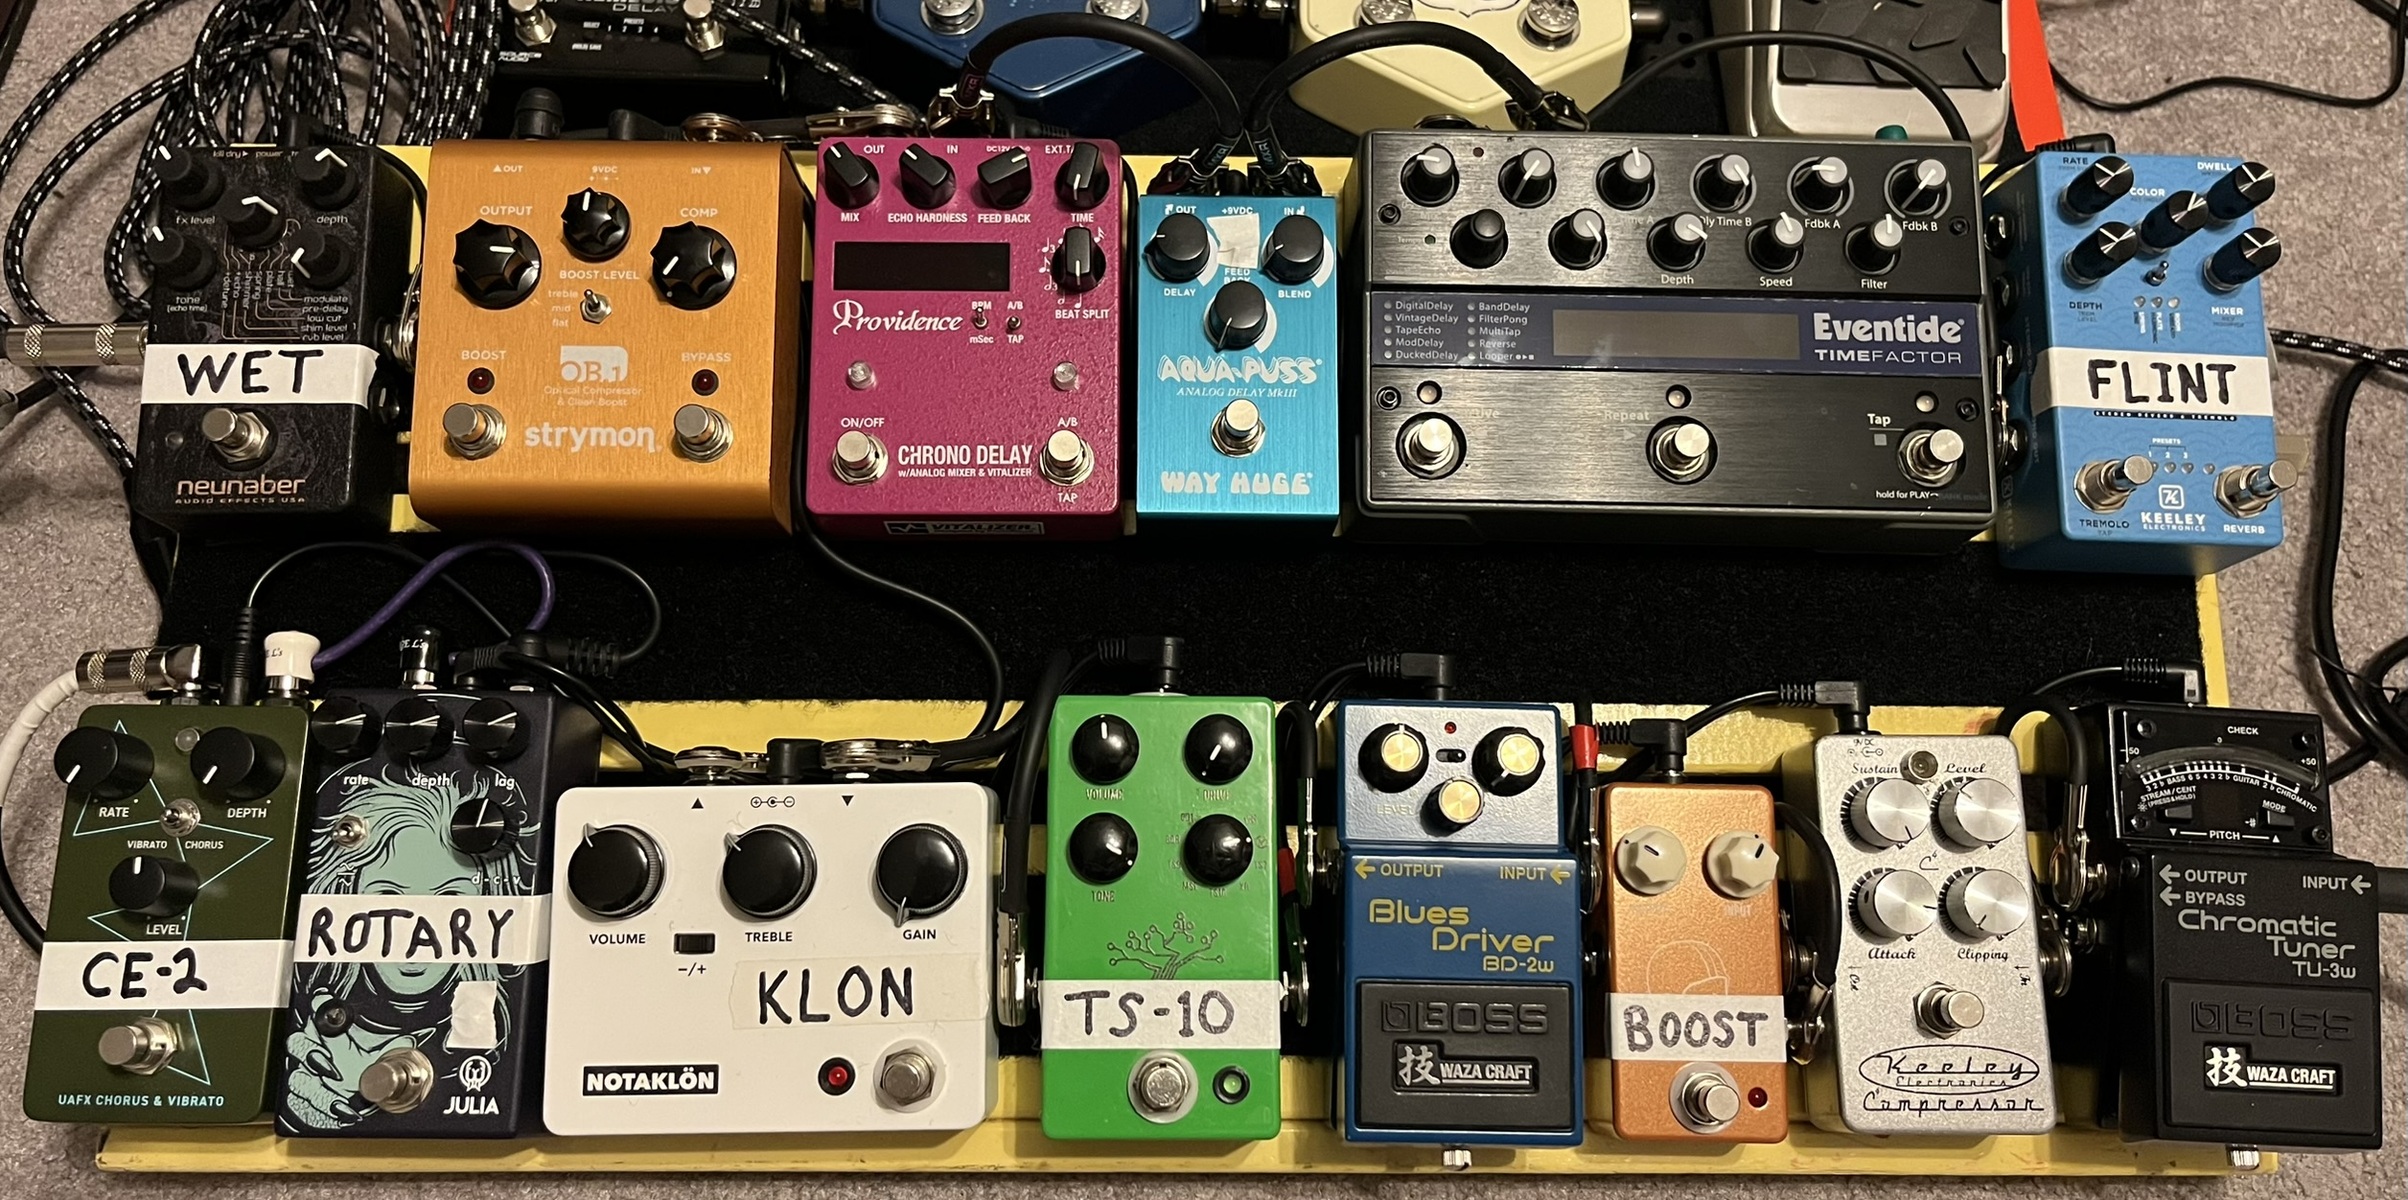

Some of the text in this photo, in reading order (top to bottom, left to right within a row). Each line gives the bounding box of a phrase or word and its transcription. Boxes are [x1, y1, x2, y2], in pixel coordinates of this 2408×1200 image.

[612, 3, 678, 12] DELAY
[864, 144, 885, 154] OUT
[946, 144, 958, 154] IN
[2062, 156, 2088, 166] RATE
[503, 164, 523, 173] OUT
[592, 166, 618, 174] 9VDC
[690, 166, 701, 174] IN
[2197, 162, 2232, 172] DWELL
[2130, 188, 2166, 196] COLOR
[480, 206, 533, 216] OUTPUT
[680, 208, 718, 218] COMP
[1176, 205, 1196, 214] OUT
[1221, 206, 1253, 215] +9VDC
[1284, 206, 1294, 215] IN
[176, 215, 216, 226] fx level
[316, 214, 348, 226] depth
[840, 212, 860, 222] MIX
[888, 213, 968, 223] ECHO HARDNESS
[978, 214, 1031, 224] FEED BACK
[1070, 213, 1094, 222] TIME
[1804, 219, 1841, 229] Fdbk A
[1902, 220, 1938, 232] Fdbk B
[559, 270, 640, 280] BOOST LEVEL
[1224, 268, 1250, 276] FEED
[1661, 274, 1694, 286] Depth
[1760, 276, 1793, 288] Speed
[1861, 278, 1888, 290] Filter
[548, 288, 578, 300] treble
[1164, 288, 1196, 298] DELAY
[1278, 290, 1312, 299] BLEND
[176, 296, 201, 304] tone
[1008, 301, 1023, 310] A/B
[2070, 301, 2103, 310] DEPTH
[302, 304, 348, 314] pre-delay
[552, 304, 572, 314] mid
[1396, 301, 1454, 312] DigitalDelay
[1479, 302, 1530, 313] BandDelay
[2211, 306, 2244, 316] MIXER
[832, 299, 963, 334] Providence
[1055, 310, 1109, 319] BEAT SPLIT
[1396, 314, 1458, 324] VintageDelay
[552, 317, 569, 328] flat
[1479, 315, 1528, 326] FilterPong
[300, 324, 348, 332] shim level
[1396, 326, 1442, 336] TapeEcho
[1480, 328, 1521, 337] MultiTap
[1813, 312, 1962, 344] Eventide
[970, 335, 994, 344] mSec
[1008, 335, 1024, 344] TAP
[1396, 338, 1444, 348] ModDelay
[1480, 340, 1516, 348] Reverse
[461, 350, 506, 361] BOOST
[682, 352, 732, 363] BYPASS
[1396, 350, 1458, 361] DuckedDelay
[1480, 352, 1514, 362] Looper
[1814, 349, 1962, 364] TIMEFACTOR
[178, 350, 324, 396] WET
[1157, 354, 1318, 384] AQUA-PUSS
[2088, 359, 2236, 405] FLINT
[1176, 387, 1298, 398] ANALOG DELAY MkIII
[1058, 417, 1078, 427] A/B
[1604, 410, 1650, 423] Repeat
[1867, 413, 1892, 427] Tap
[840, 418, 884, 428] ON/OFF
[524, 422, 656, 453] strymon
[898, 445, 1033, 466] CHRONO DELAY
[898, 468, 1032, 478] w/ANALOG MIXER & VITALIZER
[176, 474, 306, 496] neunaber
[1160, 471, 1310, 495] WAY HUGE
[1058, 492, 1078, 503] TAP
[2140, 512, 2206, 525] KEELEY
[2080, 519, 2130, 530] TREMOLO
[2143, 524, 2206, 532] ELECTRONICS
[2223, 524, 2265, 534] REVERB
[2228, 726, 2259, 736] CHECK
[2300, 758, 2316, 766] +50
[1851, 762, 1898, 774] Sustain
[1944, 762, 1987, 774] Level
[343, 775, 369, 786] rate
[412, 774, 451, 788] depth
[494, 773, 515, 790] lag
[1086, 788, 1124, 800] VOLUME
[2262, 800, 2287, 812] MODE
[98, 806, 130, 818] RATE
[227, 808, 267, 818] DEPTH
[2209, 830, 2241, 841] PITCH
[127, 840, 168, 848] VIBRATO
[184, 840, 224, 850] CHORUS
[1380, 864, 1444, 878] OUTPUT
[1500, 866, 1547, 880] INPUT
[2184, 869, 2248, 885] OUTPUT
[2302, 876, 2348, 890] INPUT
[1092, 890, 1115, 902] TONE
[2185, 890, 2246, 906] BYPASS
[1369, 898, 1470, 926] Blues
[2178, 908, 2337, 938] Chromatic
[146, 924, 182, 935] LEVEL
[308, 906, 514, 958] ROTARY
[902, 929, 937, 940] GAIN
[589, 934, 646, 945] VOLUME
[744, 931, 793, 942] TREBLE
[1432, 926, 1554, 954] Driver
[2266, 935, 2356, 960] Tuner
[1868, 948, 1916, 960] Attack
[1957, 948, 2009, 962] Clipping
[1483, 956, 1554, 972] BD-2w
[2292, 960, 2356, 978] TU-3w
[82, 948, 208, 999] CE-2
[758, 965, 913, 1025] KLON
[1064, 990, 1235, 1038] TS-10
[1416, 1001, 1548, 1035] BOSS
[2225, 1001, 2354, 1041] BOSS
[1624, 1004, 1768, 1052] BOOST
[1398, 1045, 1440, 1086] 技
[1440, 1062, 1533, 1080] WAZA CRAFT
[1875, 1054, 2025, 1080] Keeley
[2206, 1047, 2248, 1088] 技
[587, 1066, 714, 1092] NOTAKLÖN
[2246, 1065, 2336, 1085] WAZA CRAFT
[1895, 1076, 2008, 1088] Electronics
[58, 1094, 225, 1107] UAFX CHORUS & VIBRATO
[443, 1096, 500, 1115] JULIA
